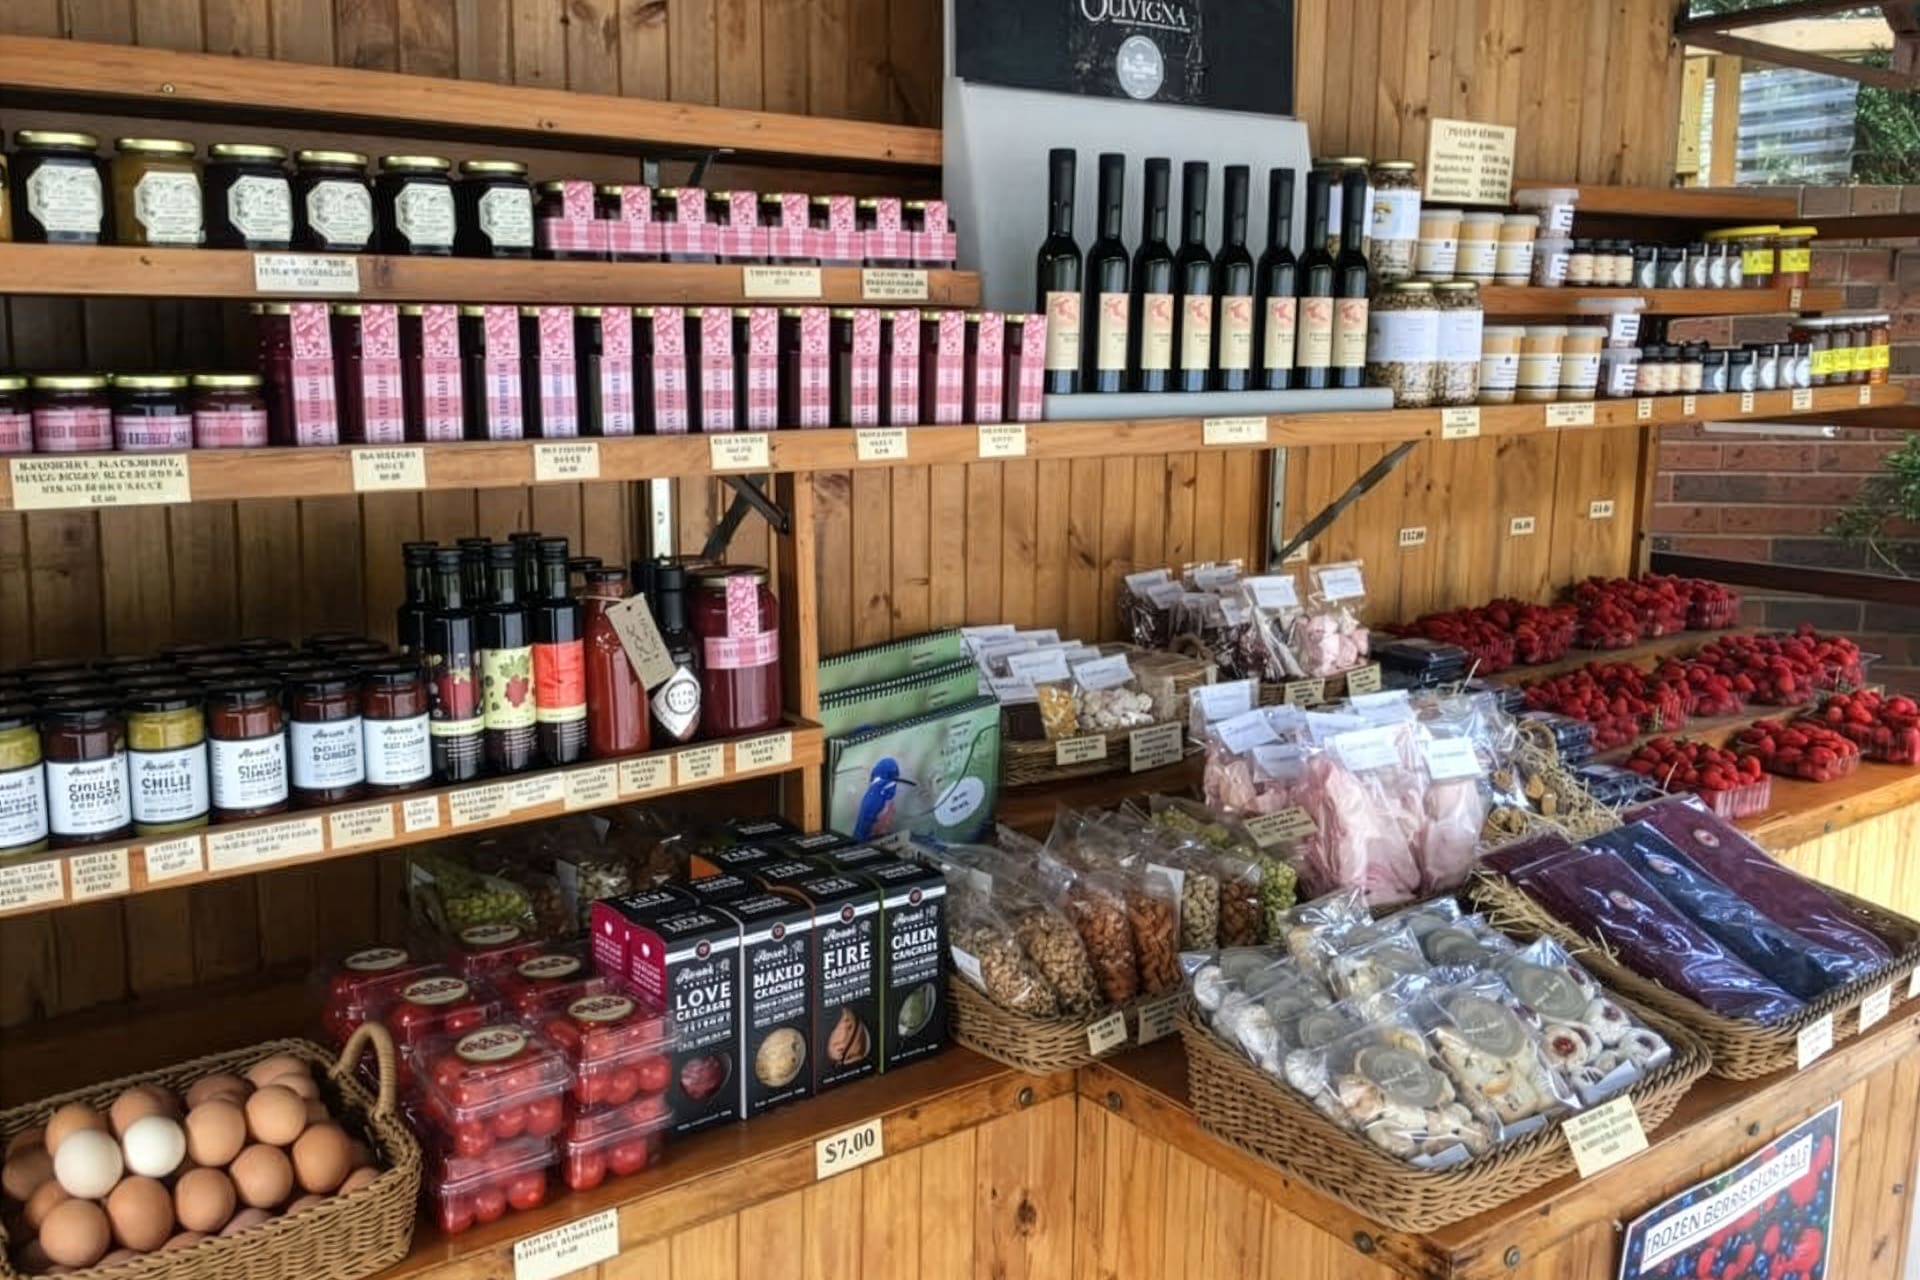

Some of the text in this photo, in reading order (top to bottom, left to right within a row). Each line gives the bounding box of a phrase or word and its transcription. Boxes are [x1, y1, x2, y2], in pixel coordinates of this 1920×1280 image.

[823, 941, 871, 970] FIRE
[676, 980, 731, 1010] LOVE
[824, 1128, 875, 1163] $7.00
